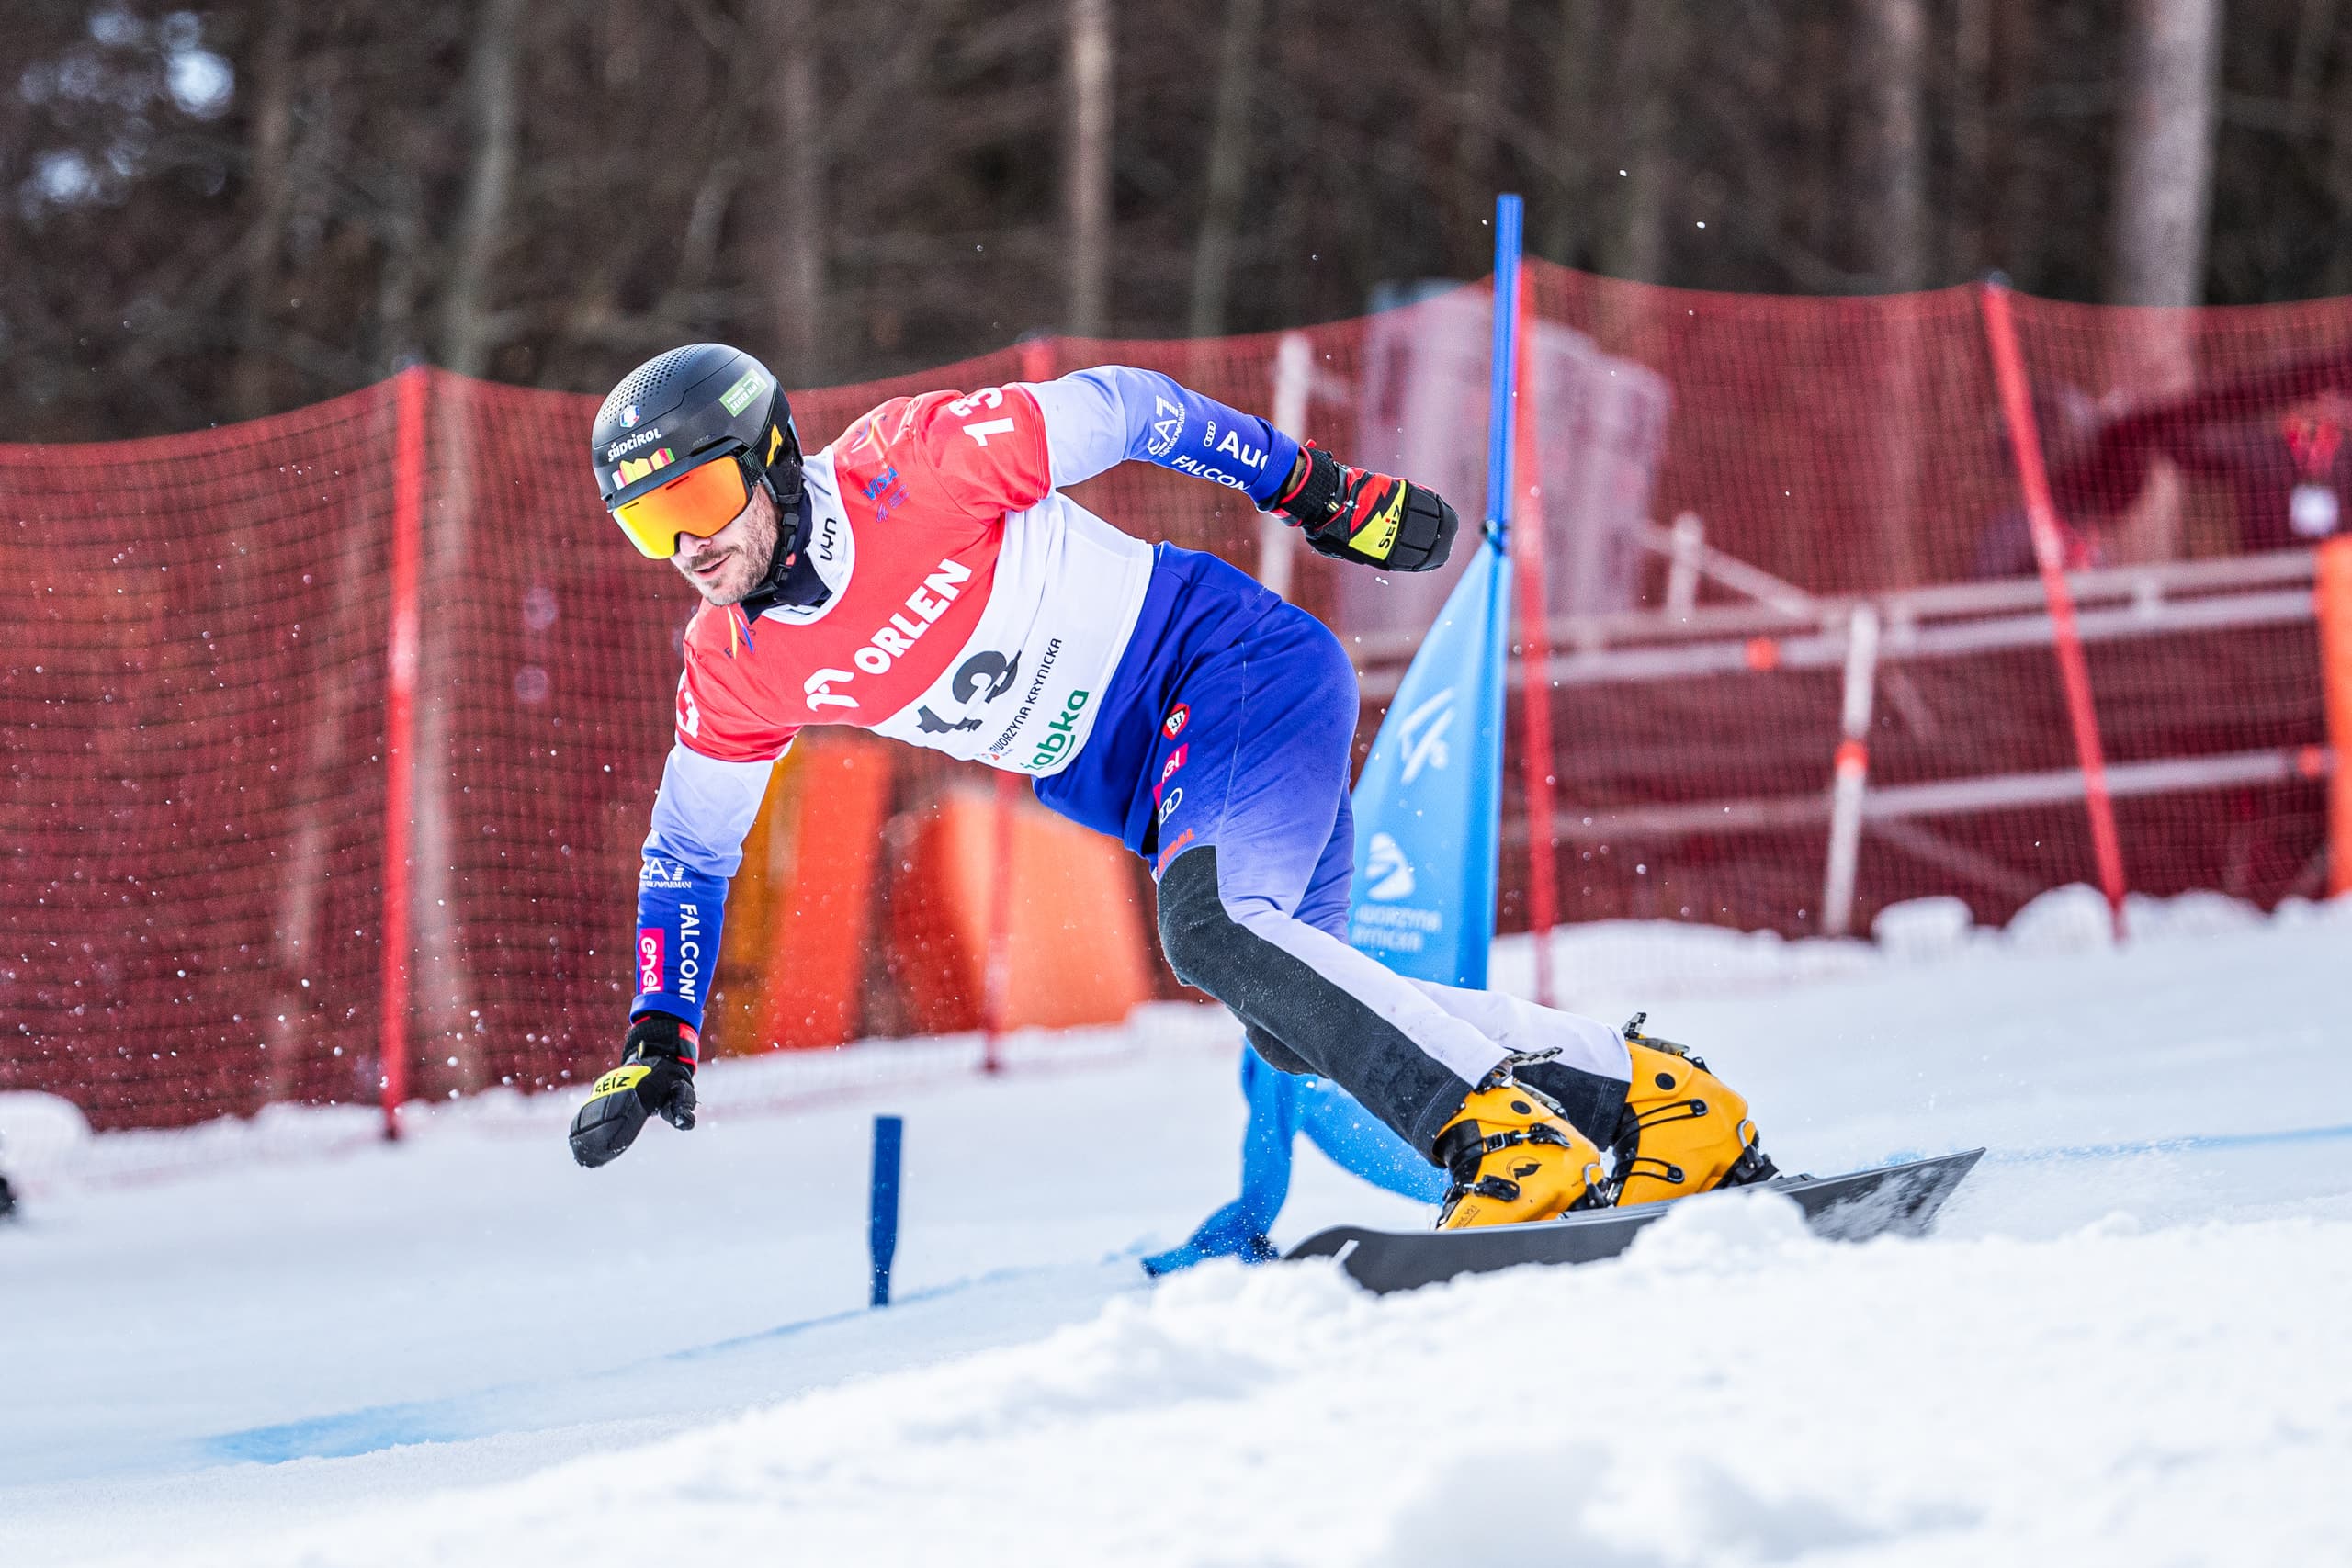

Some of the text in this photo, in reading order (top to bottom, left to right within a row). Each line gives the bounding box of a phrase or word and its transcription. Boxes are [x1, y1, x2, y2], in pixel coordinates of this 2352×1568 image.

[948, 387, 1015, 447] 13
[863, 466, 899, 501] VISA
[854, 558, 973, 675] ORLEN
[1025, 637, 1063, 705] KRYNICKA
[640, 936, 662, 994] enel
